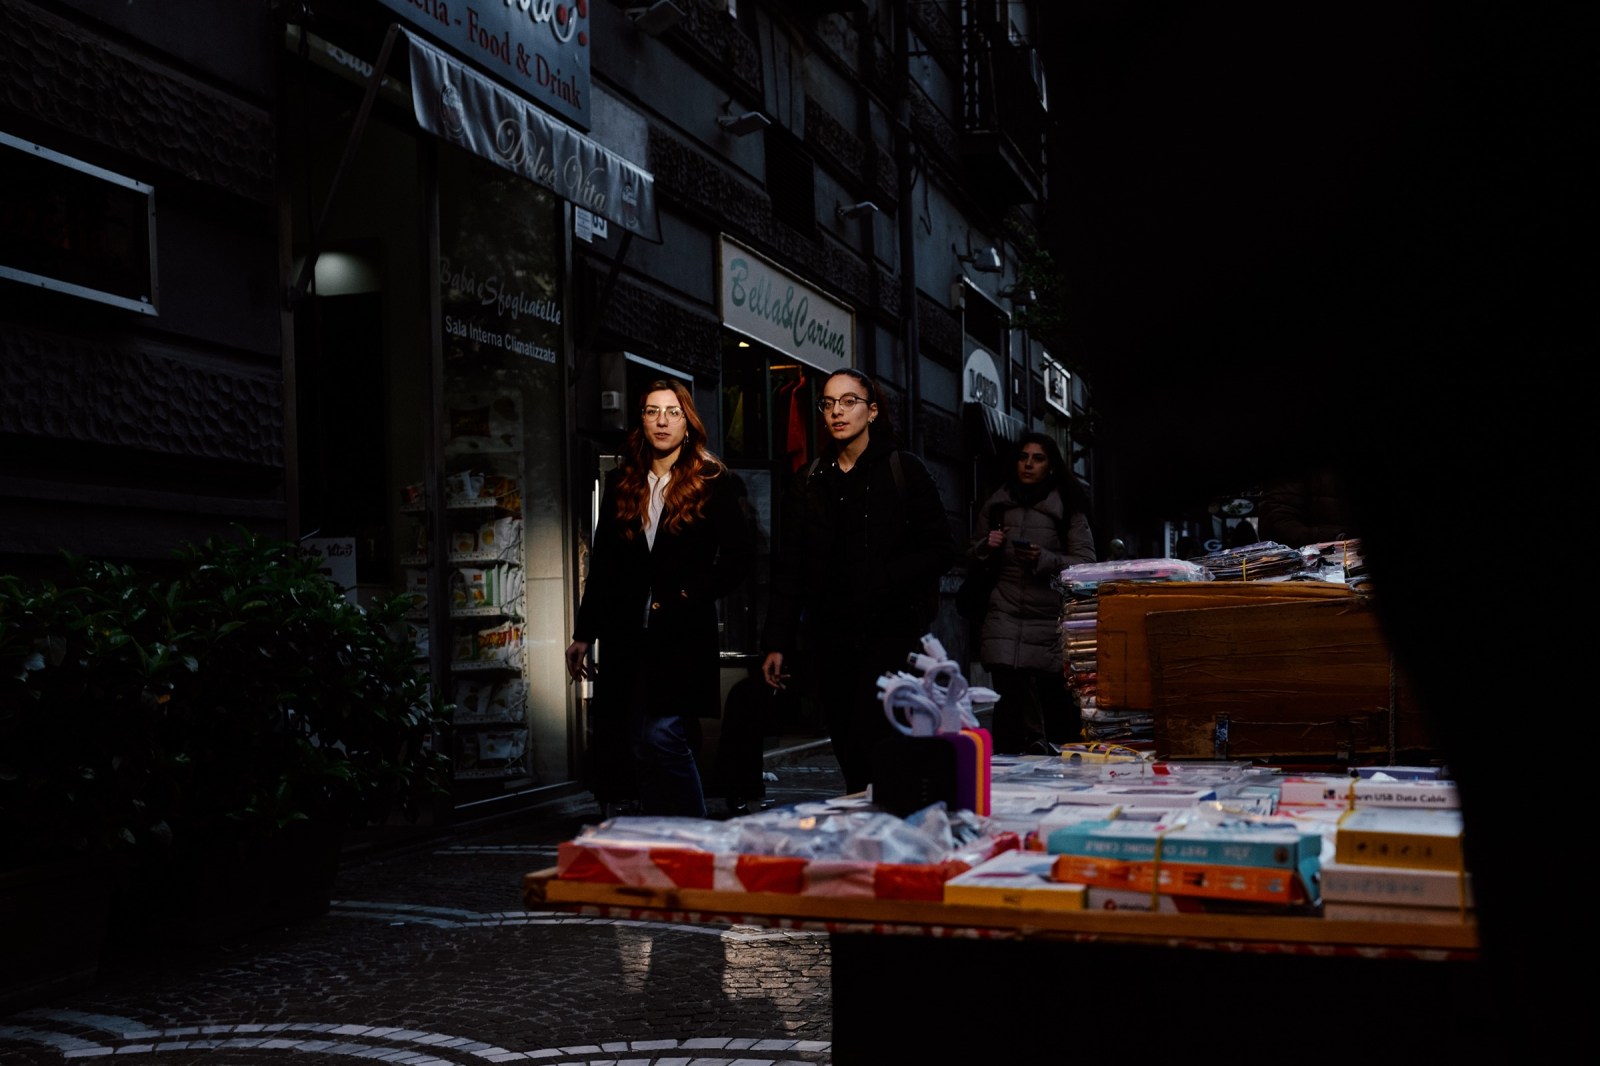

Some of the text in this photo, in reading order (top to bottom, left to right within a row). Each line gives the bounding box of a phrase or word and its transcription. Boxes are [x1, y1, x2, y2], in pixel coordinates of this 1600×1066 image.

[466, 7, 511, 66] Food
[516, 42, 533, 78] &
[536, 54, 582, 110] Drink
[496, 118, 608, 213] Dolce Vita
[481, 275, 561, 326] Sfogliatelle
[730, 257, 845, 358] Bella&Carina
[444, 314, 557, 364] Sala Interna Climatizzata
[1375, 793, 1393, 801] USB
[1396, 794, 1418, 802] Data
[1420, 794, 1447, 803] Cable
